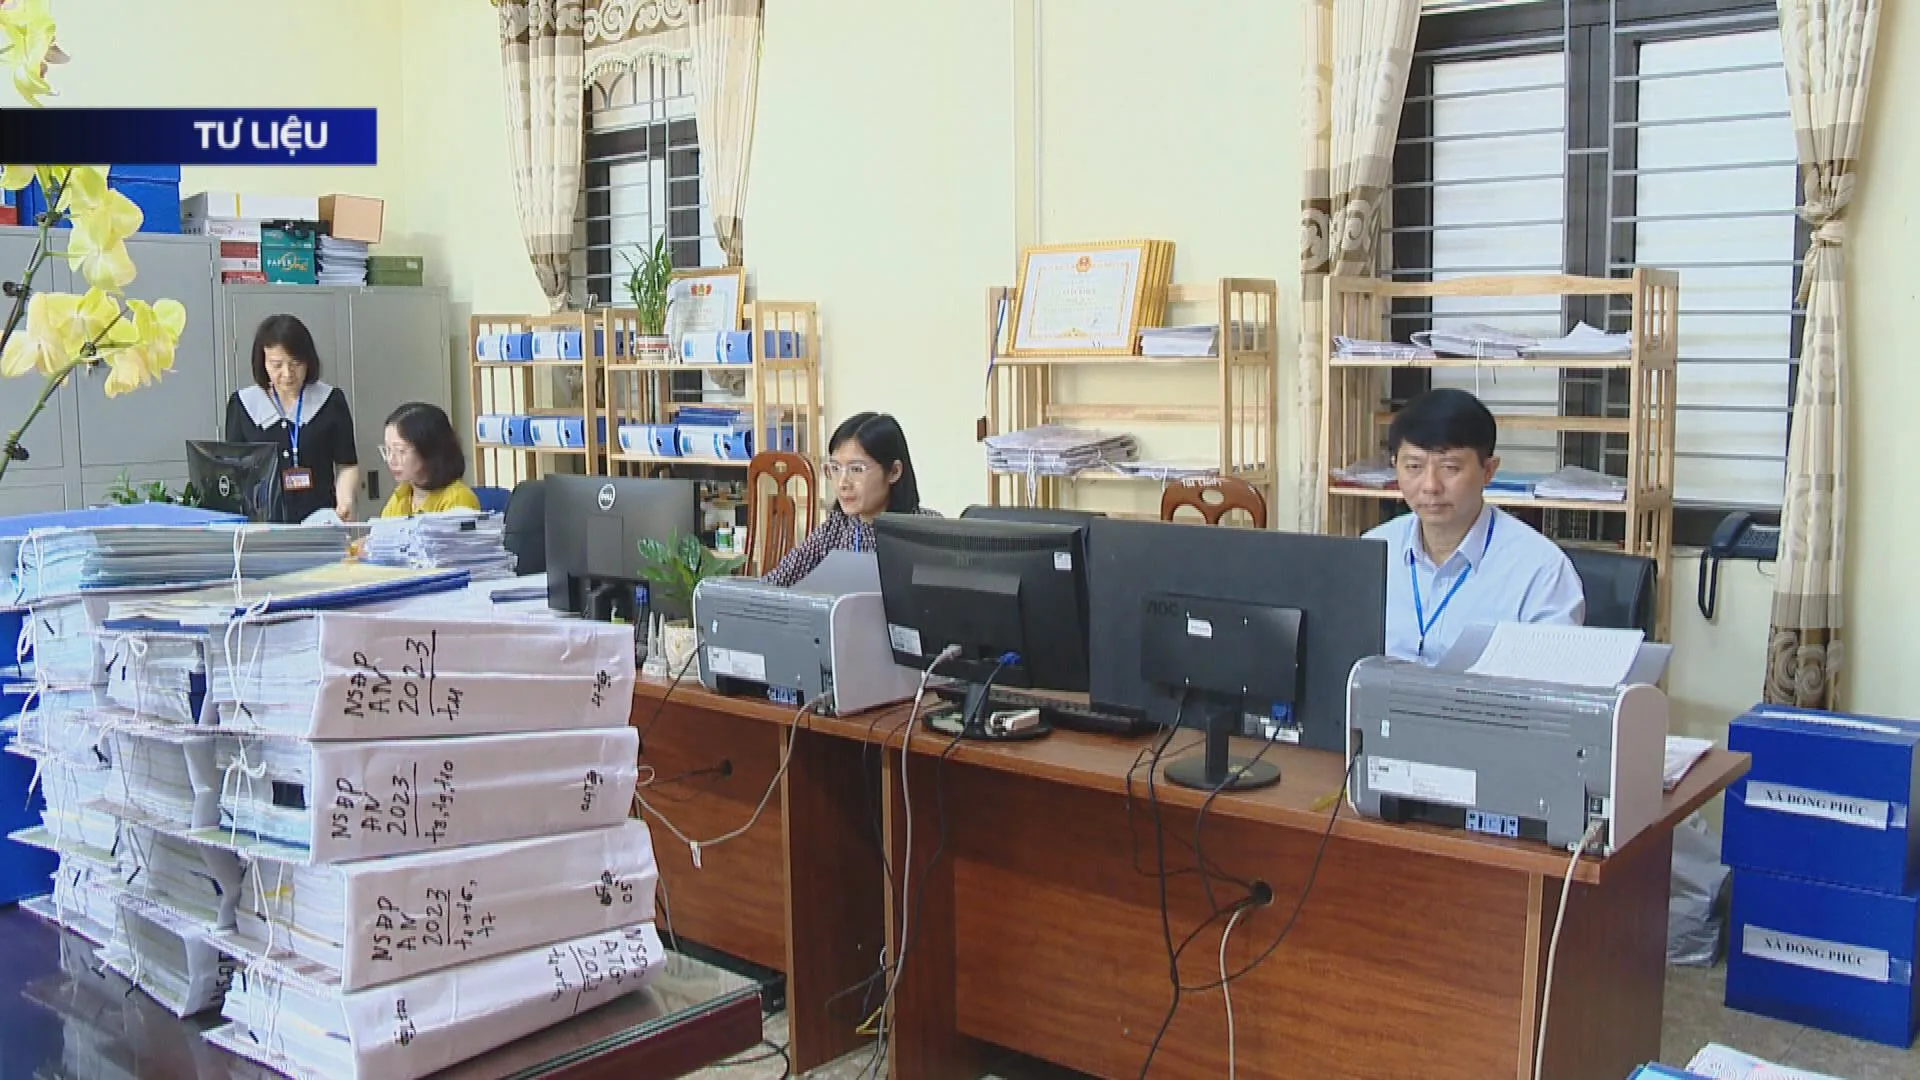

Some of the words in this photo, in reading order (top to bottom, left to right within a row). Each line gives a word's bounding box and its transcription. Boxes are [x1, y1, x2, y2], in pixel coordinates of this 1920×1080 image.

[398, 637, 429, 717] 2023
[387, 775, 411, 836] 2023
[422, 887, 448, 947] 2023
